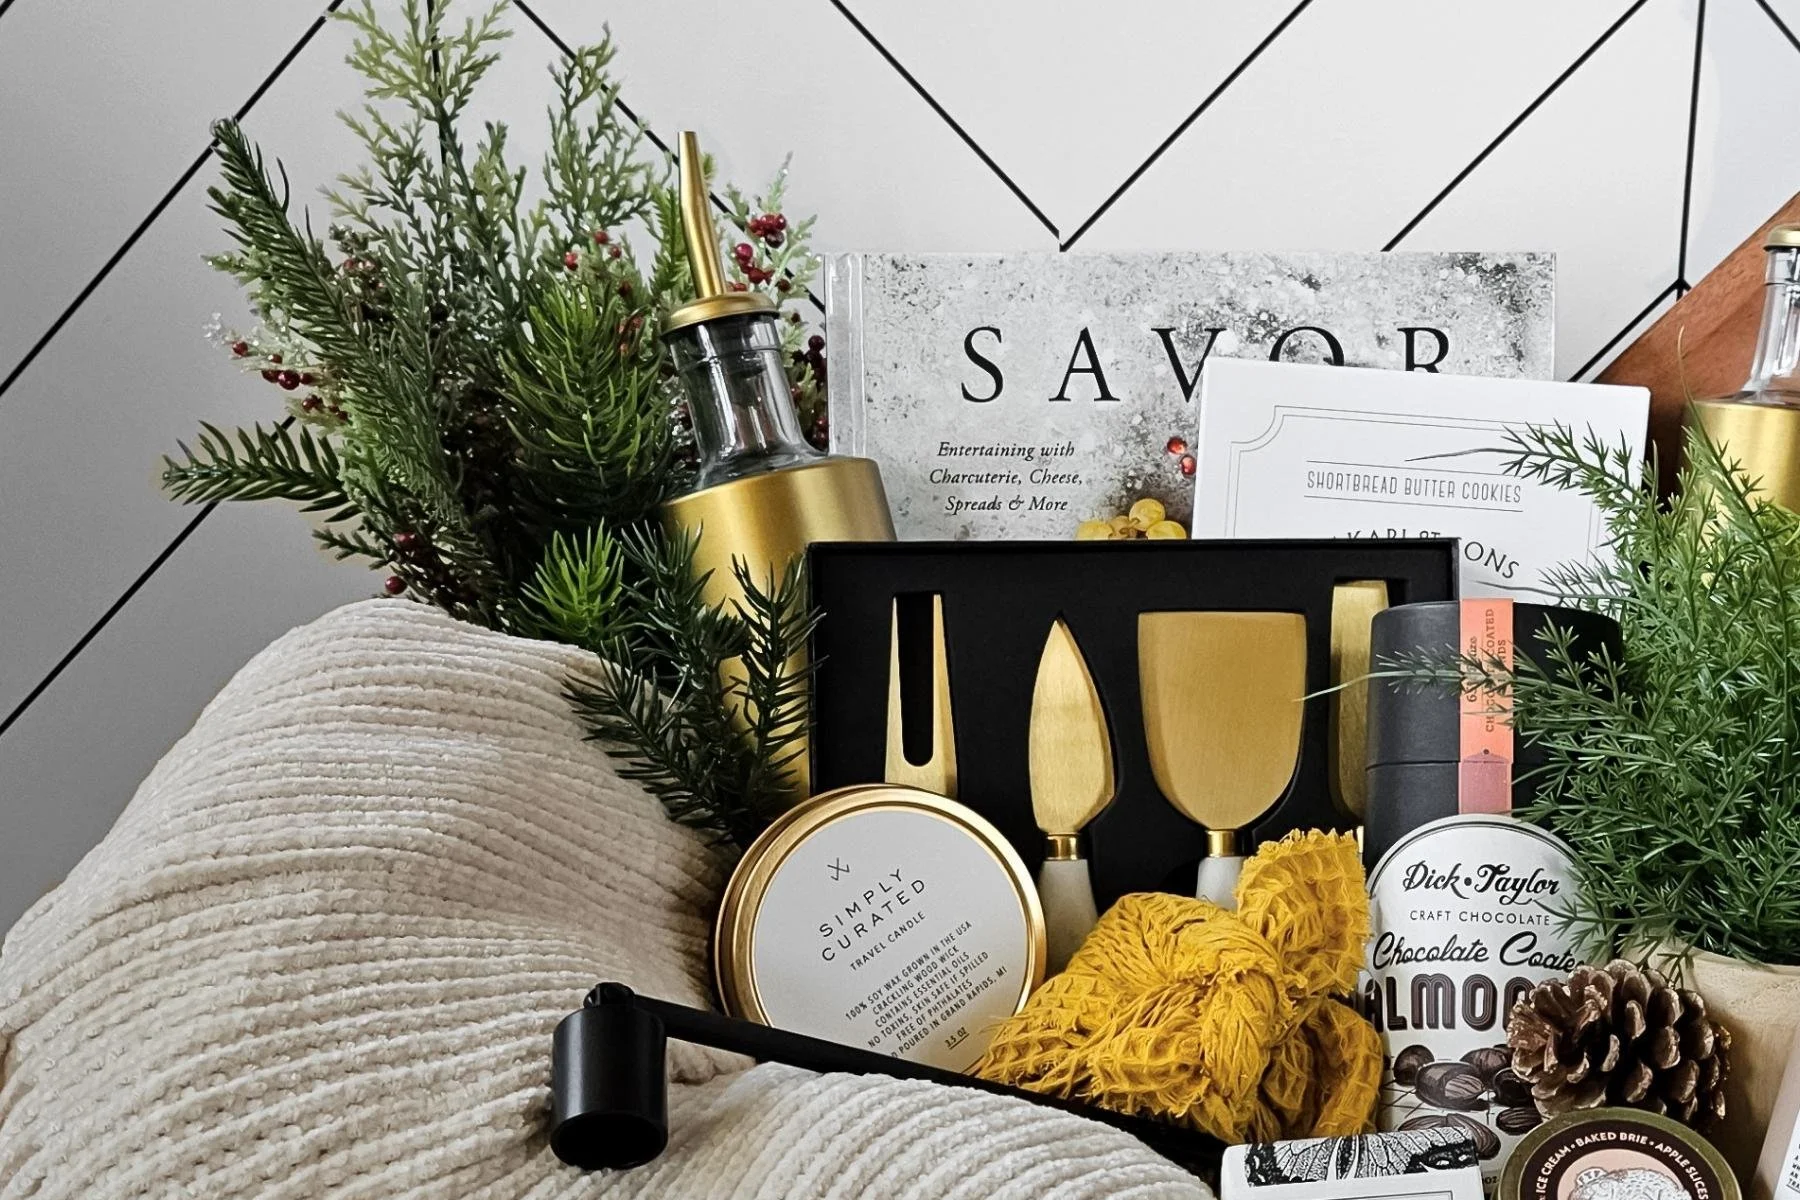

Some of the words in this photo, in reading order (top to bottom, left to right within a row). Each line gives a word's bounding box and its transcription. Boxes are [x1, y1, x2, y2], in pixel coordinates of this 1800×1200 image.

[937, 441, 1035, 461] Entertaining
[1040, 441, 1075, 457] with
[929, 468, 1022, 485] Charcuterie,
[1029, 468, 1083, 485] Cheese,
[1307, 470, 1398, 494] SHORTBREAD
[1404, 477, 1456, 498] BUTTER
[1462, 482, 1521, 503] COOKIES
[945, 495, 1002, 515] Spreads
[1008, 495, 1024, 511] &
[1028, 496, 1068, 511] More
[1485, 608, 1496, 656] COATED
[1402, 860, 1470, 900] Dick
[1474, 864, 1560, 905] Taylor
[819, 868, 903, 938] SIMPLY
[822, 879, 926, 962] CURATED
[1410, 910, 1451, 922] CRAFT
[1459, 911, 1550, 926] CHOCOLATE
[850, 942, 886, 971] TRAVEL
[888, 911, 926, 943] CANDLE
[1372, 931, 1489, 970] Chocolate
[1500, 931, 1585, 973] Coate
[845, 1001, 868, 1021] 100%
[867, 988, 884, 1004] SOY
[884, 976, 901, 991] WAX
[901, 954, 930, 978] GROWN
[930, 945, 941, 956] IN
[940, 933, 956, 948] THE
[956, 921, 972, 936] USA
[872, 980, 914, 1015] CRACKLING
[914, 961, 938, 982] WOOD
[939, 944, 960, 963] WICK
[875, 996, 913, 1028] CONTAINS
[913, 966, 952, 999] ESSENTIAL
[952, 951, 970, 969] OILS
[868, 1036, 881, 1048] NO
[912, 998, 931, 1015] SKIN
[931, 984, 951, 1000] SAFE
[950, 975, 959, 985] IF
[959, 951, 989, 977] SPILLED
[896, 1025, 916, 1041] FREE
[916, 1016, 926, 1026] OF
[927, 979, 973, 1016] PHTHALATES
[899, 1028, 930, 1054] POURED
[931, 1020, 940, 1031] IN
[940, 999, 966, 1022] GRAND
[967, 977, 997, 1000] RAPIDS,
[996, 966, 1007, 978] MI
[958, 1026, 967, 1037] OZ
[1575, 1132, 1617, 1147] BAKED
[1620, 1132, 1648, 1145] BRIE
[1655, 1143, 1690, 1168] APPLE
[1541, 1145, 1572, 1176] CREAM
[1536, 1176, 1548, 1193] ICE
[1685, 1165, 1709, 1200] SLICES
